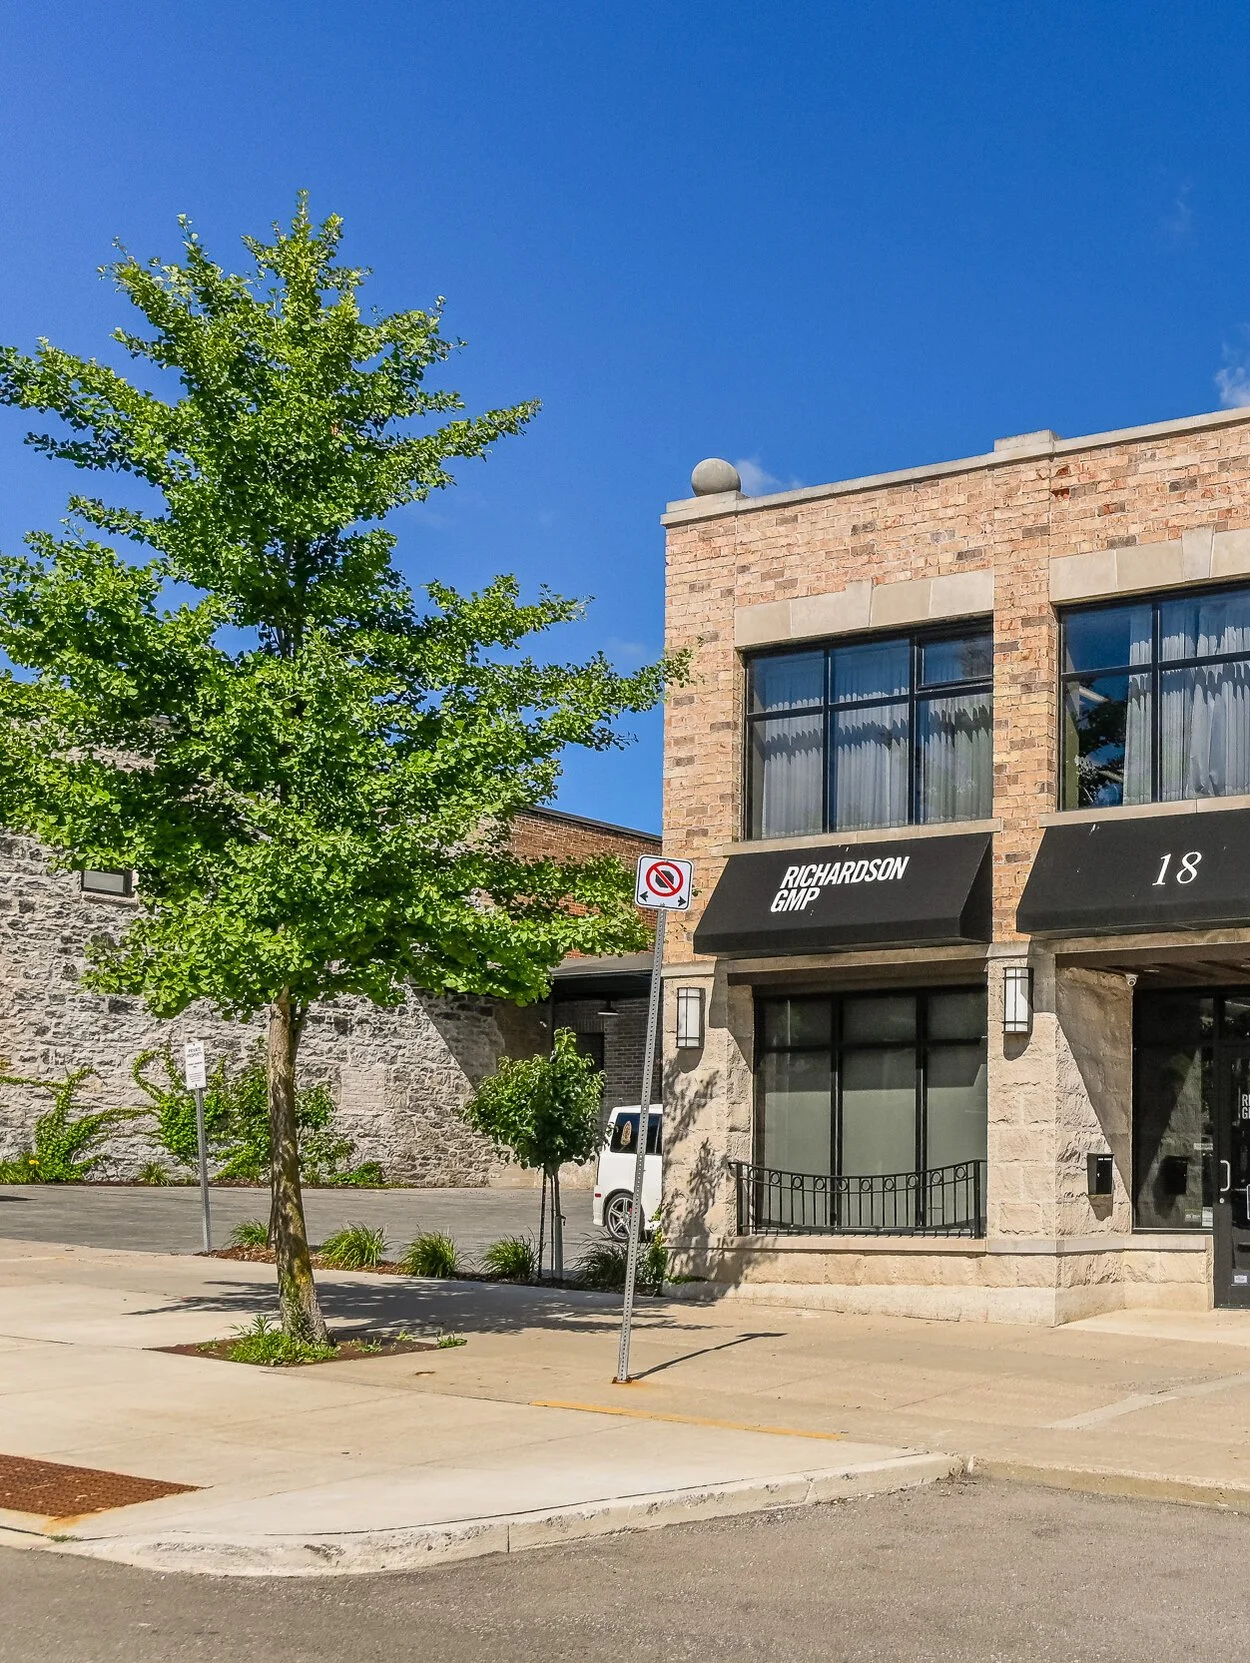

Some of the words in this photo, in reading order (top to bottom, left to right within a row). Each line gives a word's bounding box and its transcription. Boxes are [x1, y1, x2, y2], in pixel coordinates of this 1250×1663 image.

[779, 856, 911, 889] RICHARDSON
[1151, 851, 1203, 887] 18
[770, 887, 821, 913] GMP
